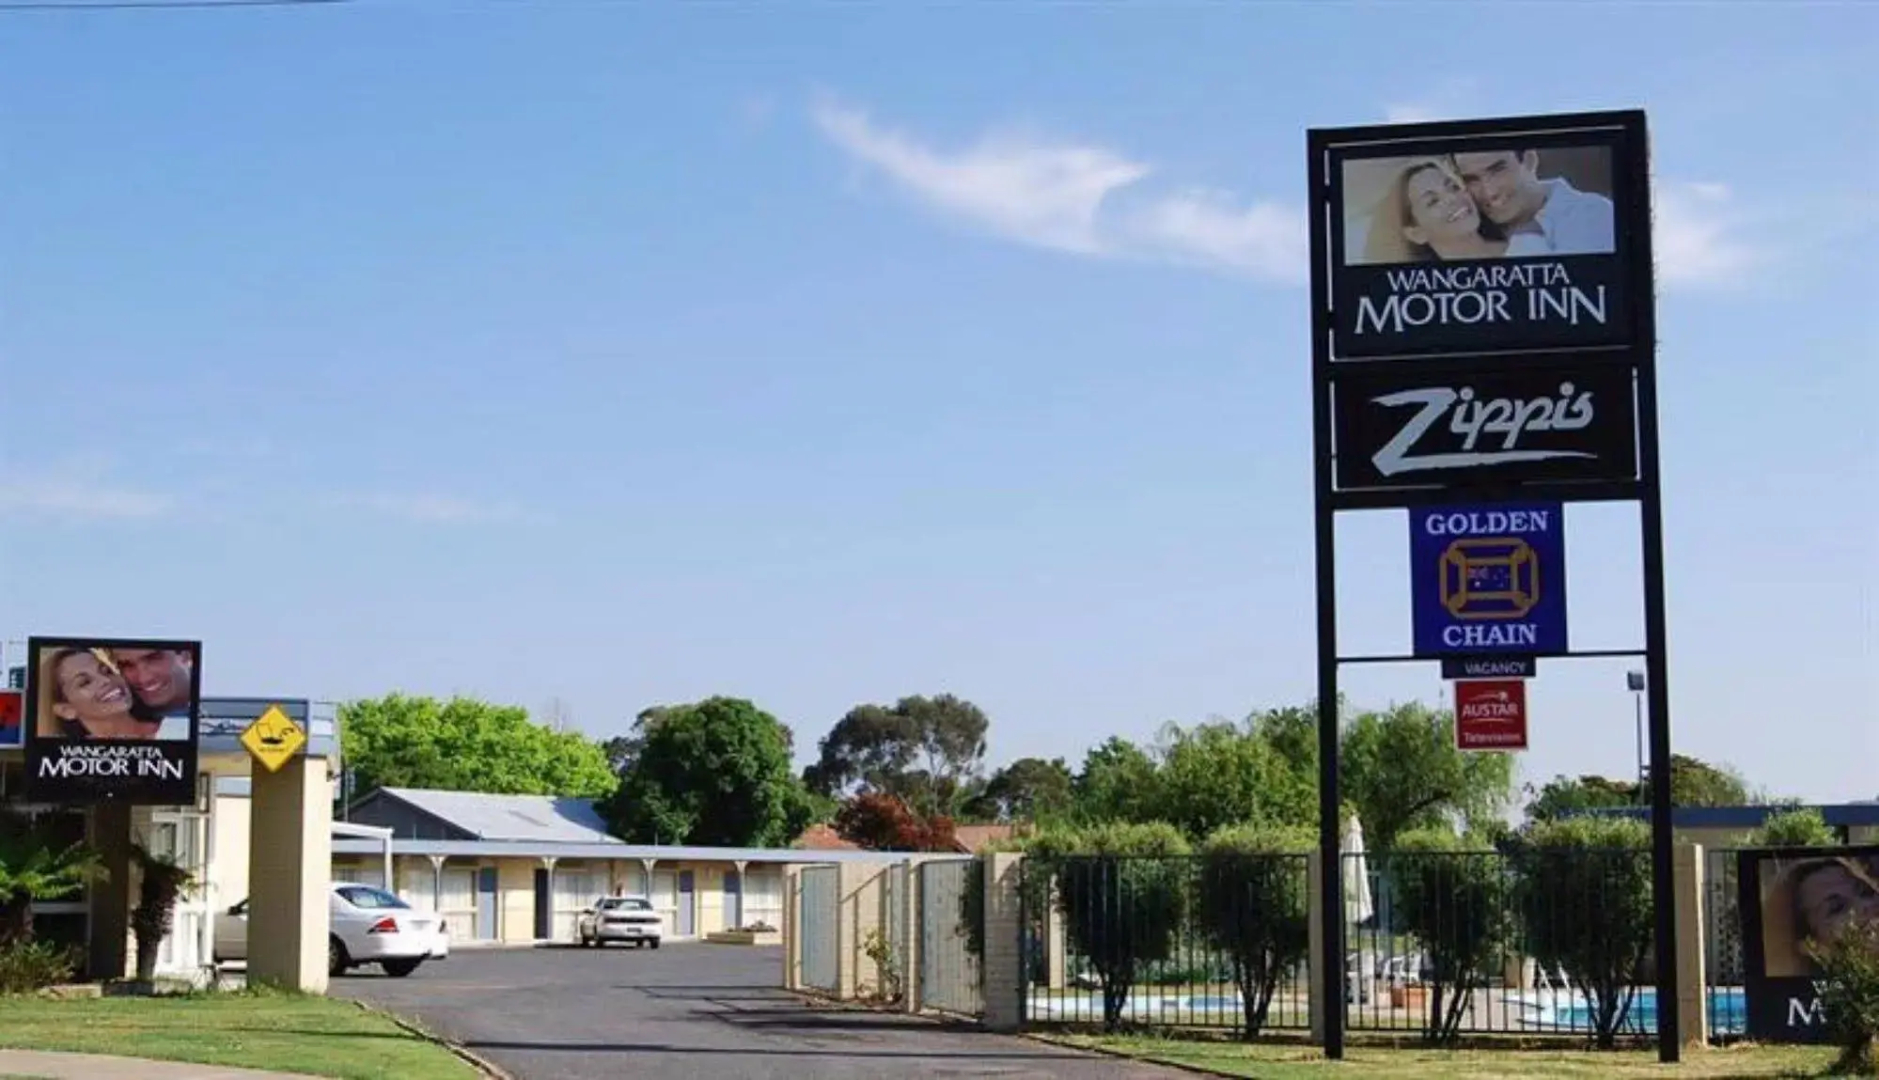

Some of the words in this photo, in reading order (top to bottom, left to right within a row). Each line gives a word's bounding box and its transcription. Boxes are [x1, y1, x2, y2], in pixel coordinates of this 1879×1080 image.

[1387, 264, 1570, 291] WANGARATTA
[1355, 292, 1511, 334] MOTOR
[1528, 286, 1606, 325] INN
[1426, 511, 1548, 535] GOLDEN
[1442, 624, 1537, 647] CHAIN
[1464, 661, 1527, 675] VACANCY
[1462, 702, 1519, 717] AUSTAR
[60, 745, 162, 758] WANGARATTA
[38, 756, 129, 778] MOTOR
[138, 759, 184, 779] INN
